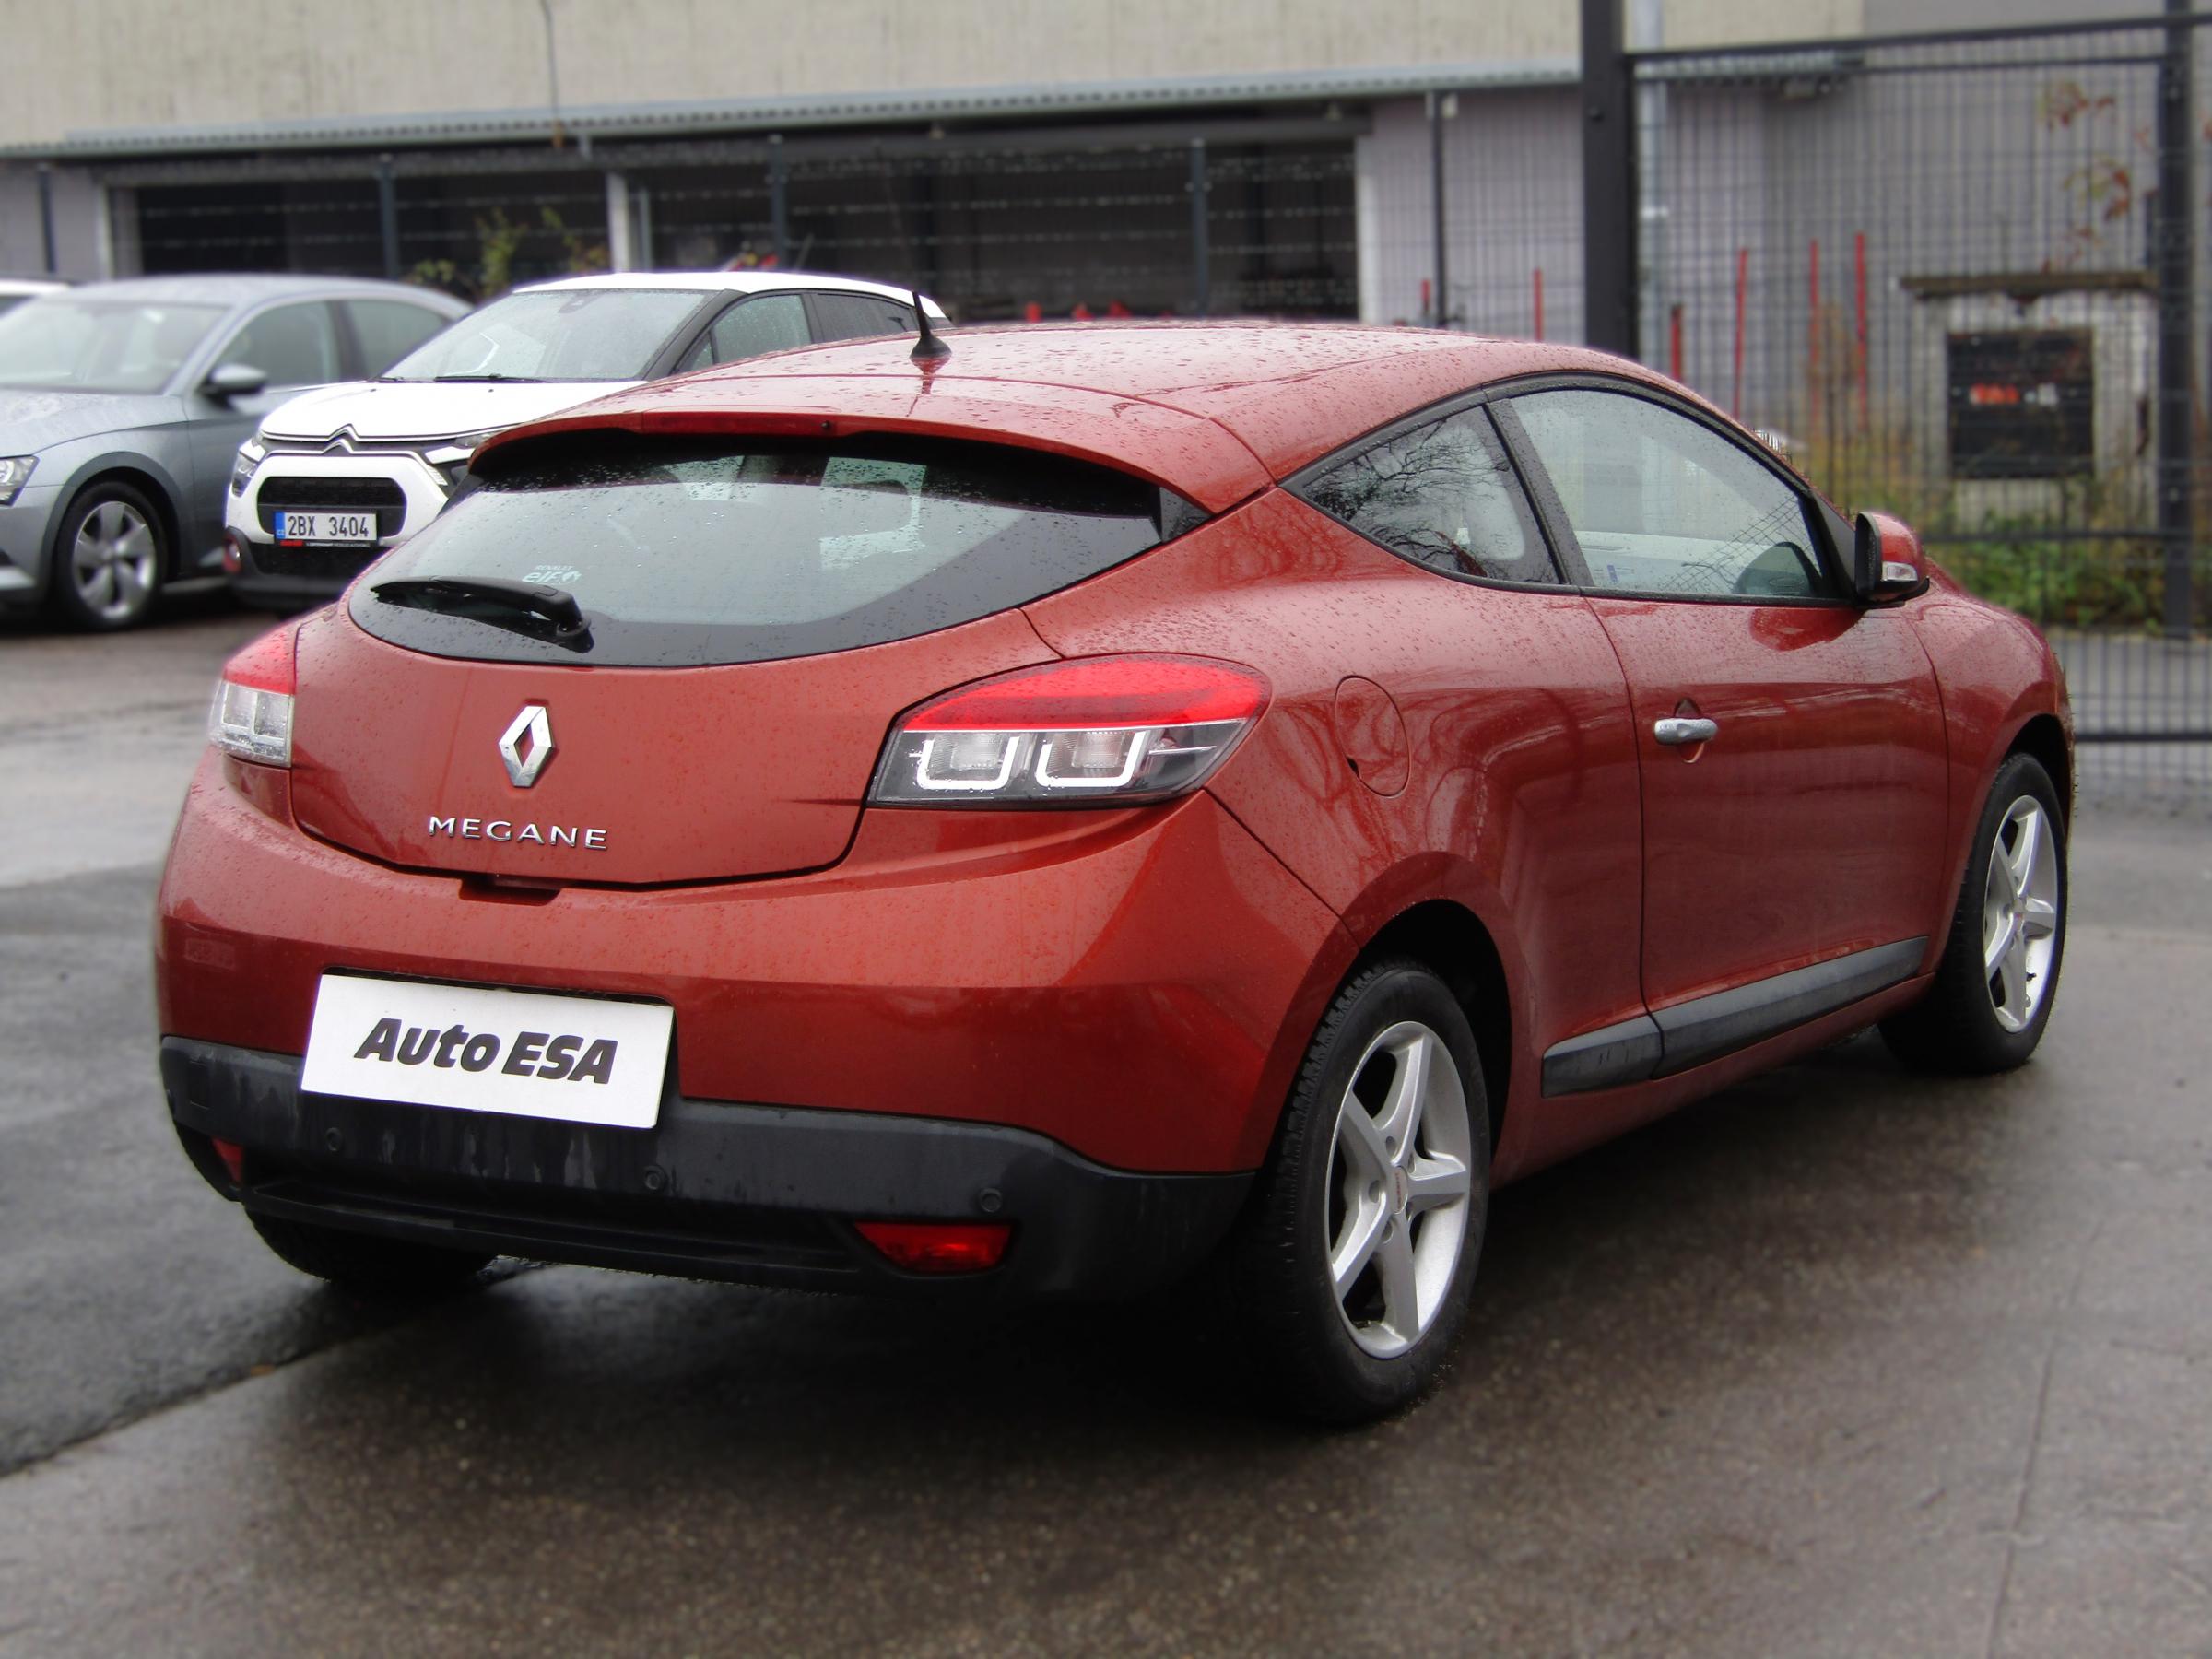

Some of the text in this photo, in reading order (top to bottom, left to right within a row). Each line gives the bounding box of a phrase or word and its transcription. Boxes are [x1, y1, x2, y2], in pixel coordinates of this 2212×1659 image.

[288, 516, 368, 537] 2BX 3404
[429, 816, 607, 850] MEGANE
[354, 1018, 618, 1085] Auto ESA
